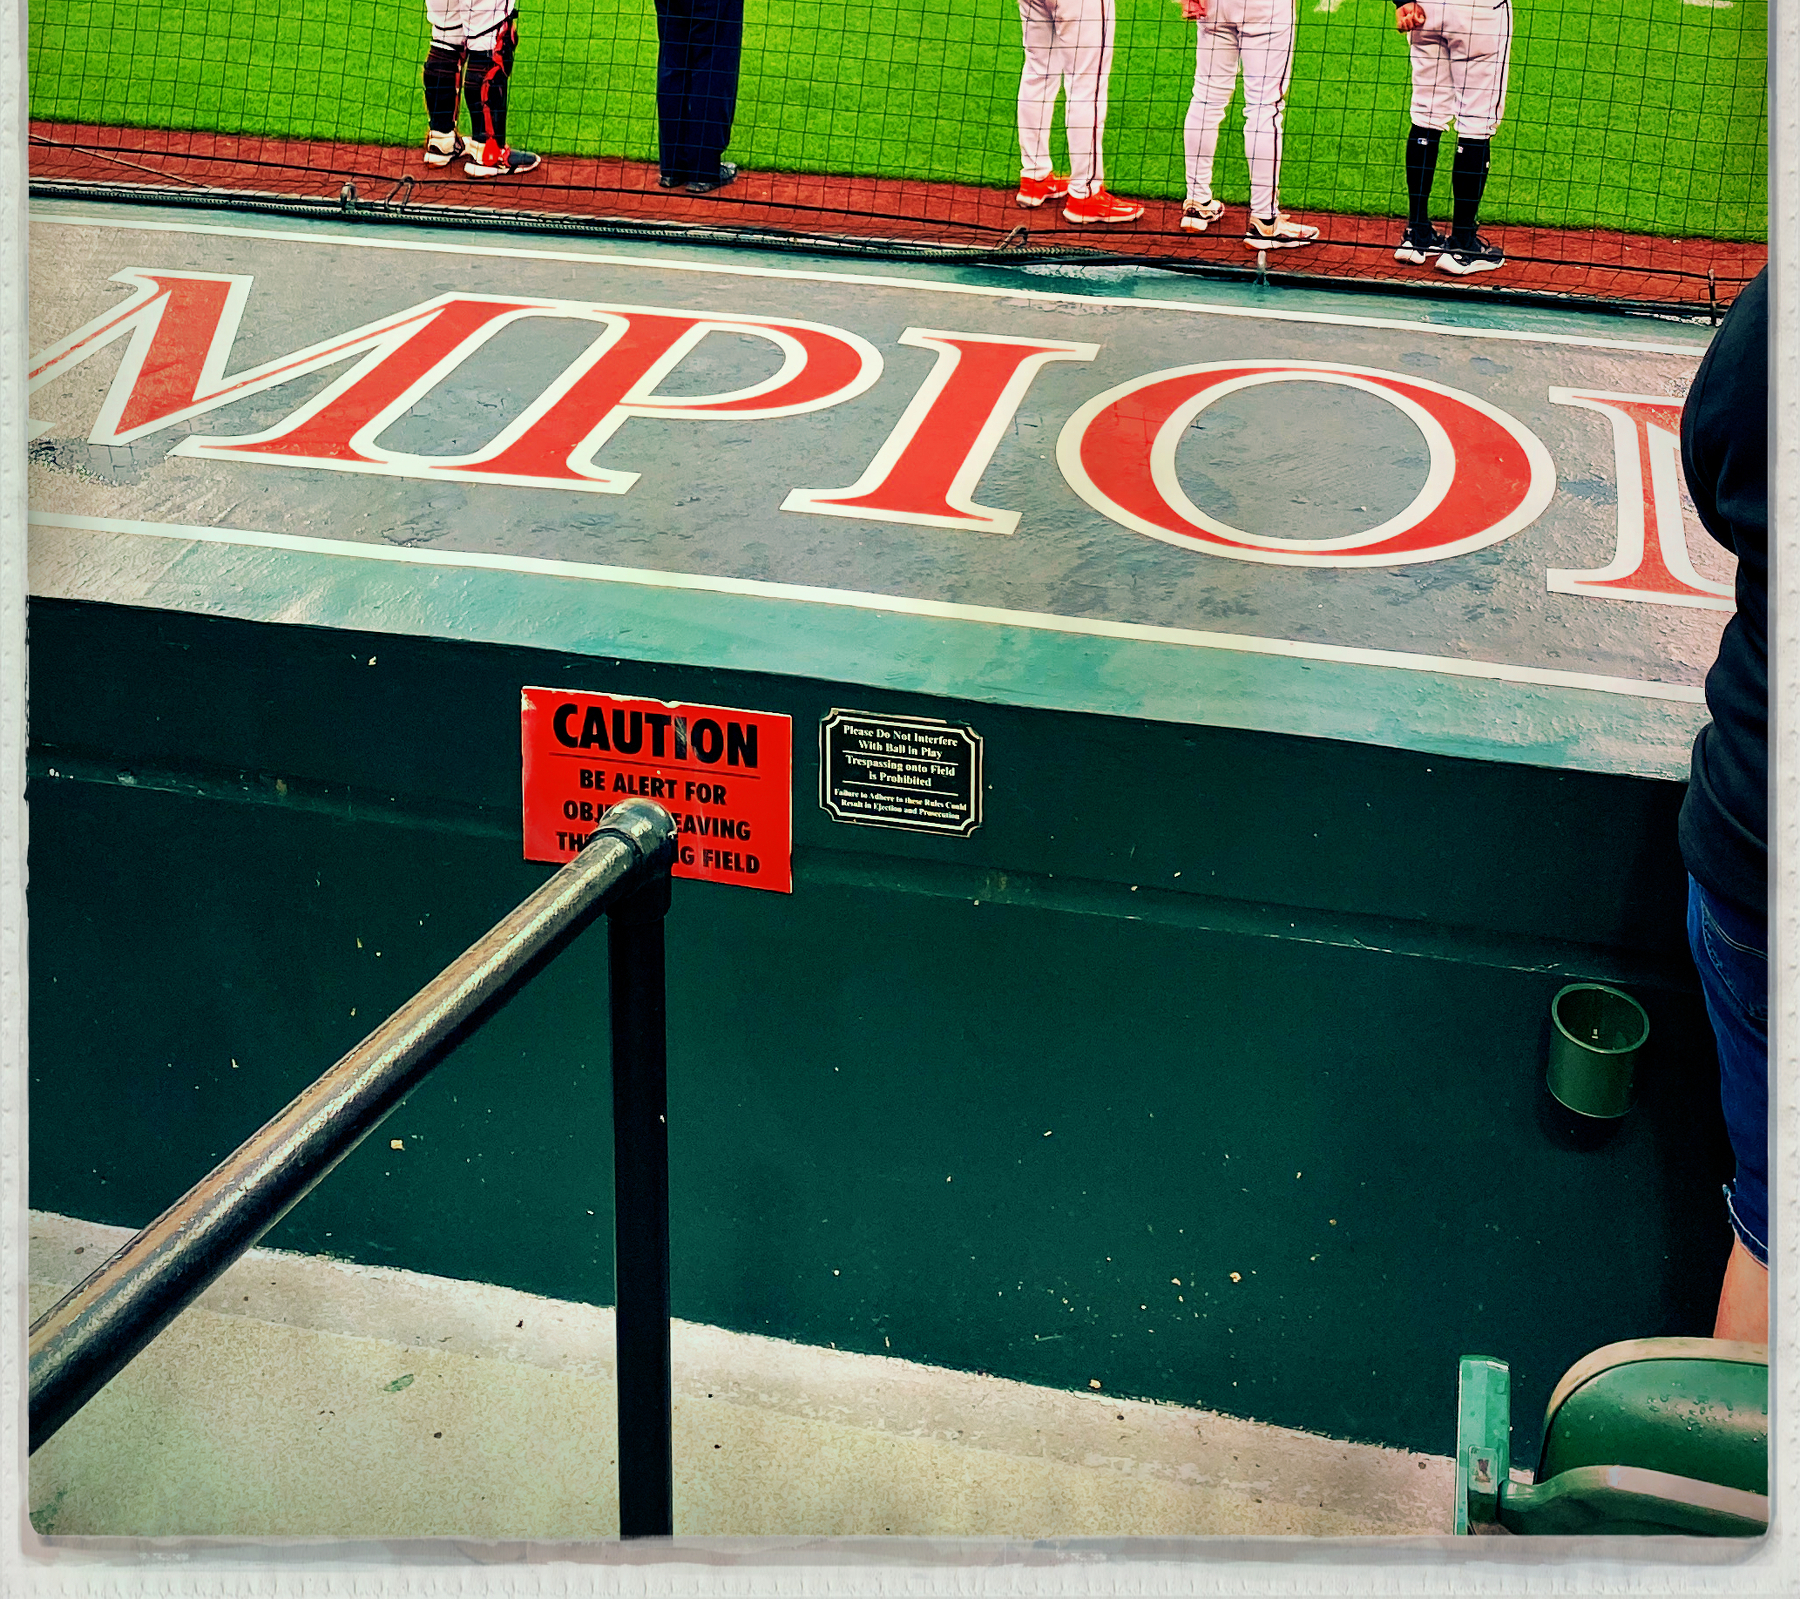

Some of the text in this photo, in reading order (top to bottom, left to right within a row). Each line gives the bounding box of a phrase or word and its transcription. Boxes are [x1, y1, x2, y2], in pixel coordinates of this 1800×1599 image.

[552, 702, 758, 769] CAUTION
[843, 724, 958, 747] Please Do Not Interfere
[858, 739, 943, 760] With Ball in Play
[844, 754, 956, 777] Trespassing onto Field
[579, 768, 728, 806] BE ALERT FOR
[879, 771, 932, 787] Prohibited
[834, 788, 860, 799] Failure
[869, 792, 895, 803] Adhere
[924, 798, 944, 808] Rules
[945, 801, 967, 812] Could
[841, 798, 863, 808] Result
[864, 800, 872, 810] in
[873, 802, 903, 814] Ejection
[903, 804, 918, 814] and
[676, 810, 751, 841] EAVING
[702, 851, 760, 875] FIELD
